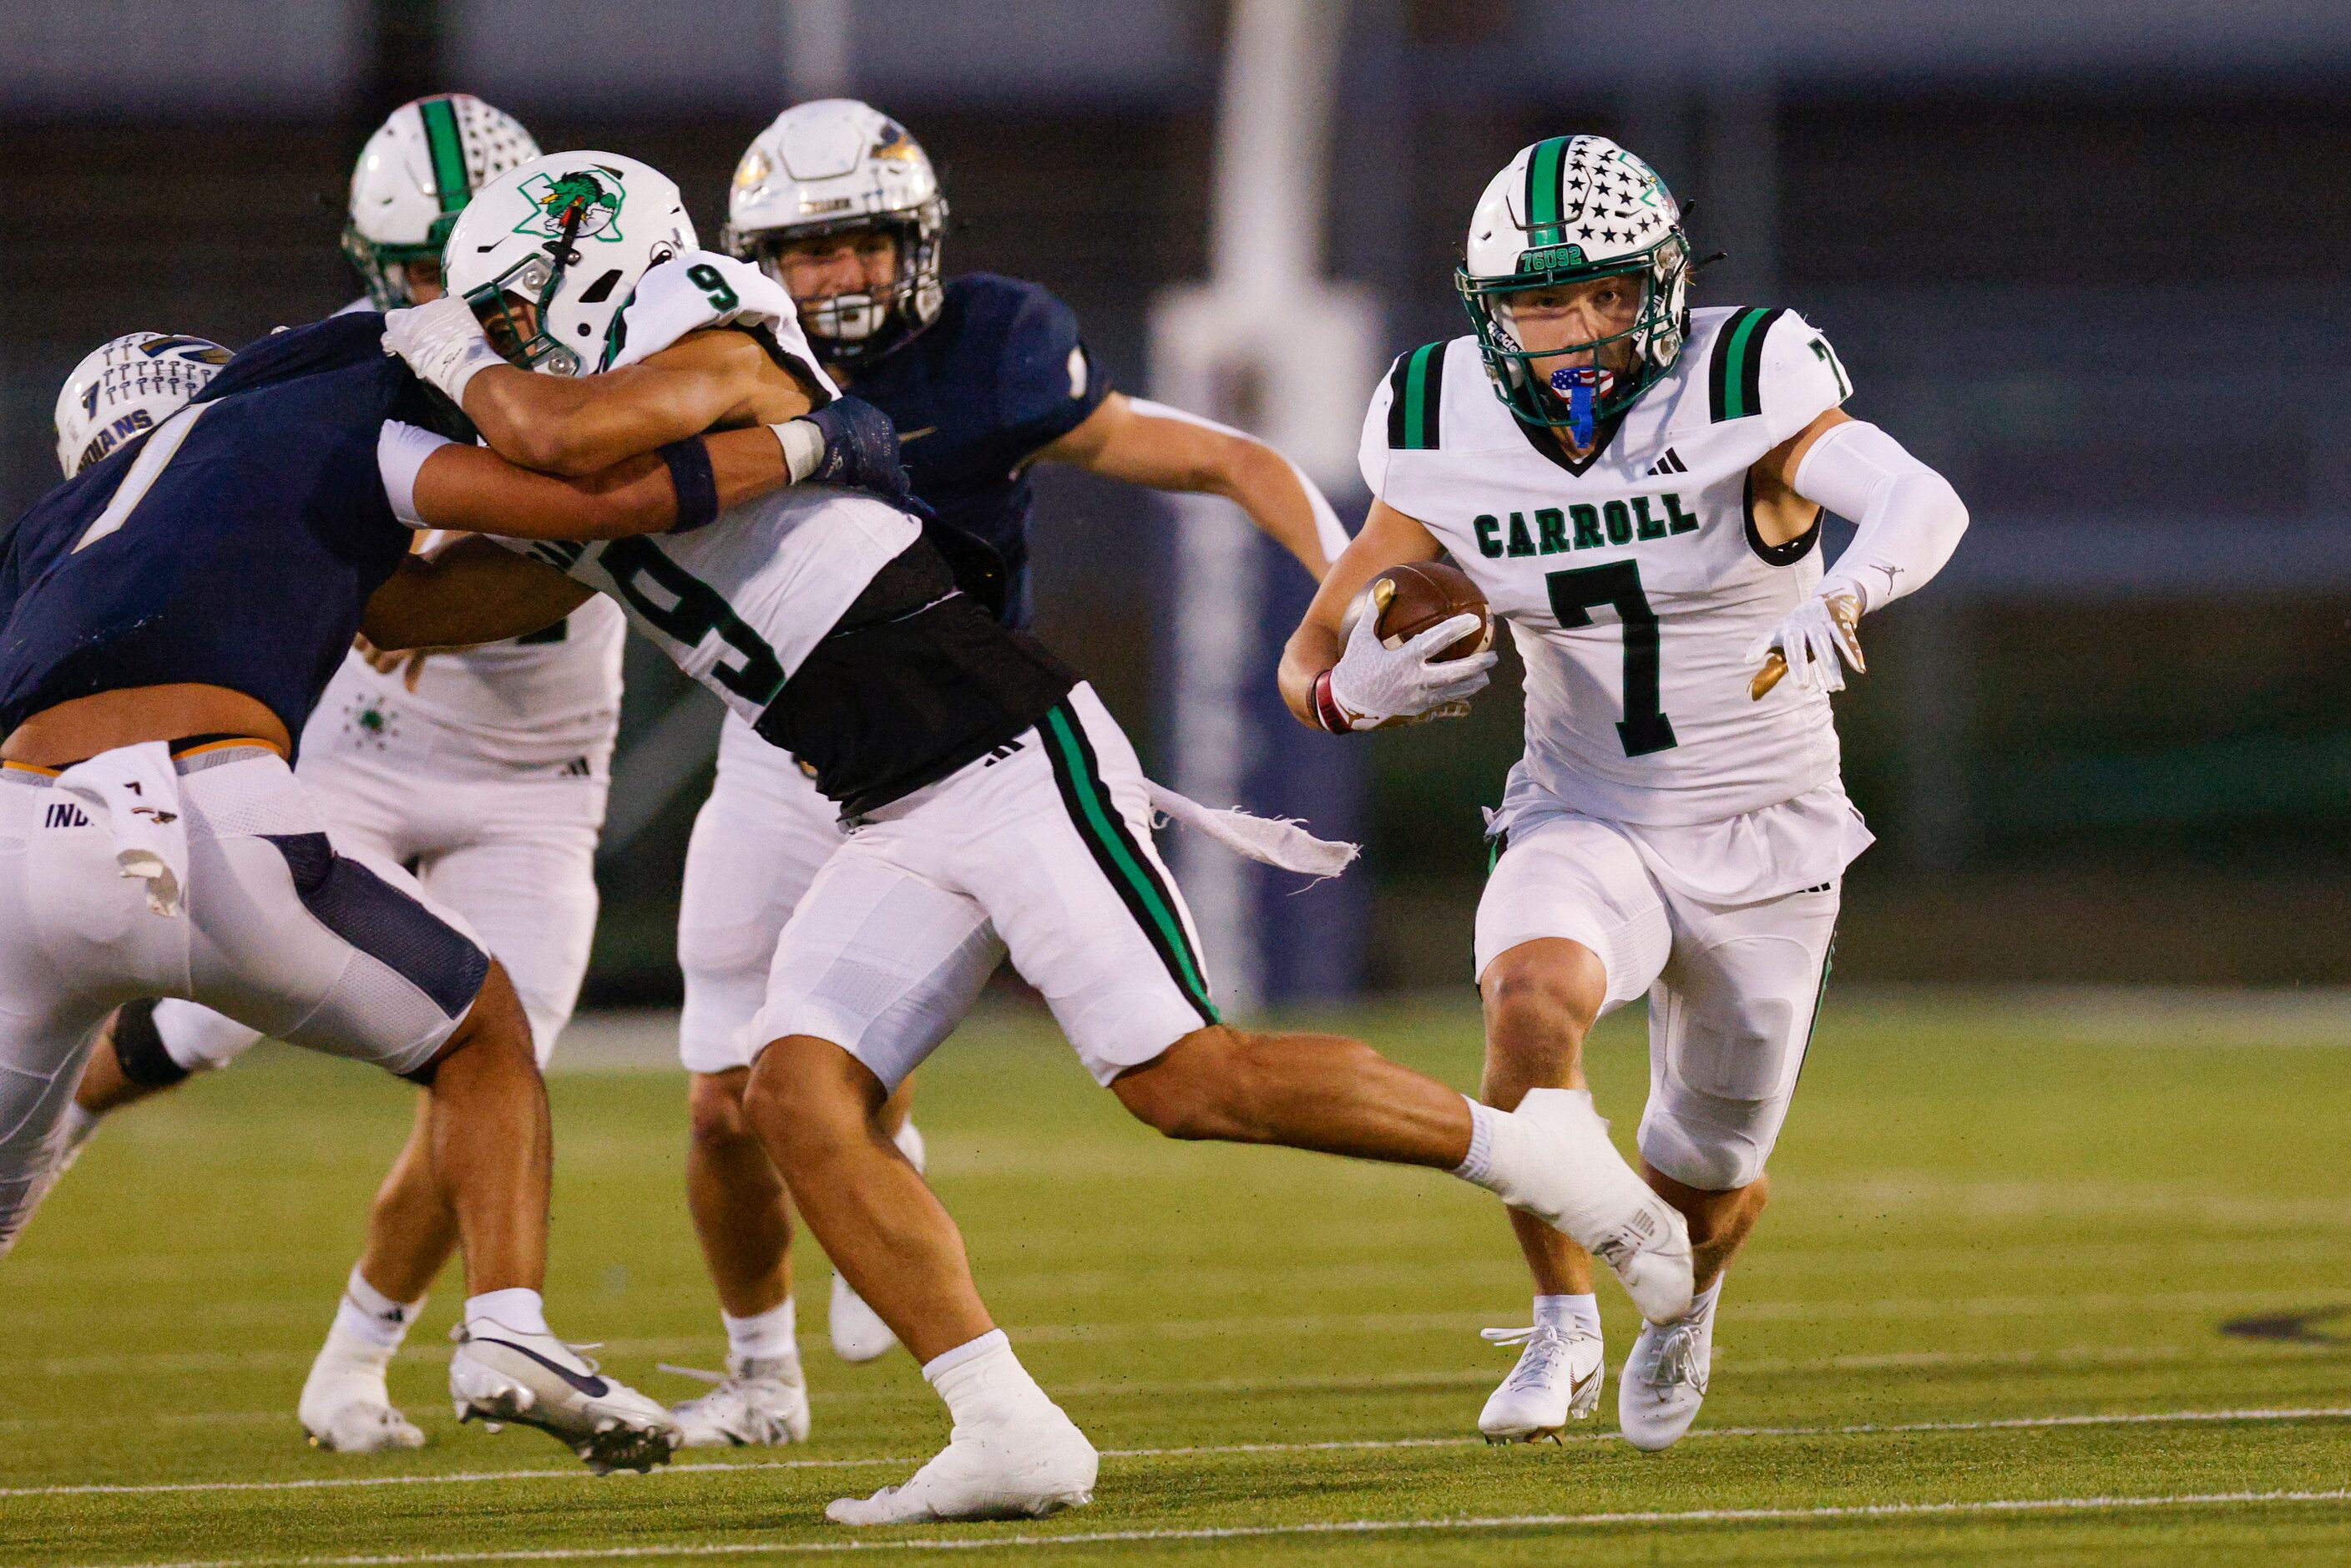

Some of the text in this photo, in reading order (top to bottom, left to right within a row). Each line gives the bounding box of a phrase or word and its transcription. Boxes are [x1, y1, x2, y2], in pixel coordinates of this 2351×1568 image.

[686, 263, 740, 314] 9
[1521, 245, 1582, 272] 76092
[1807, 336, 1848, 402] 7
[1473, 493, 1700, 559] CARROLL
[598, 534, 786, 708] 9
[1545, 559, 1678, 758] 7
